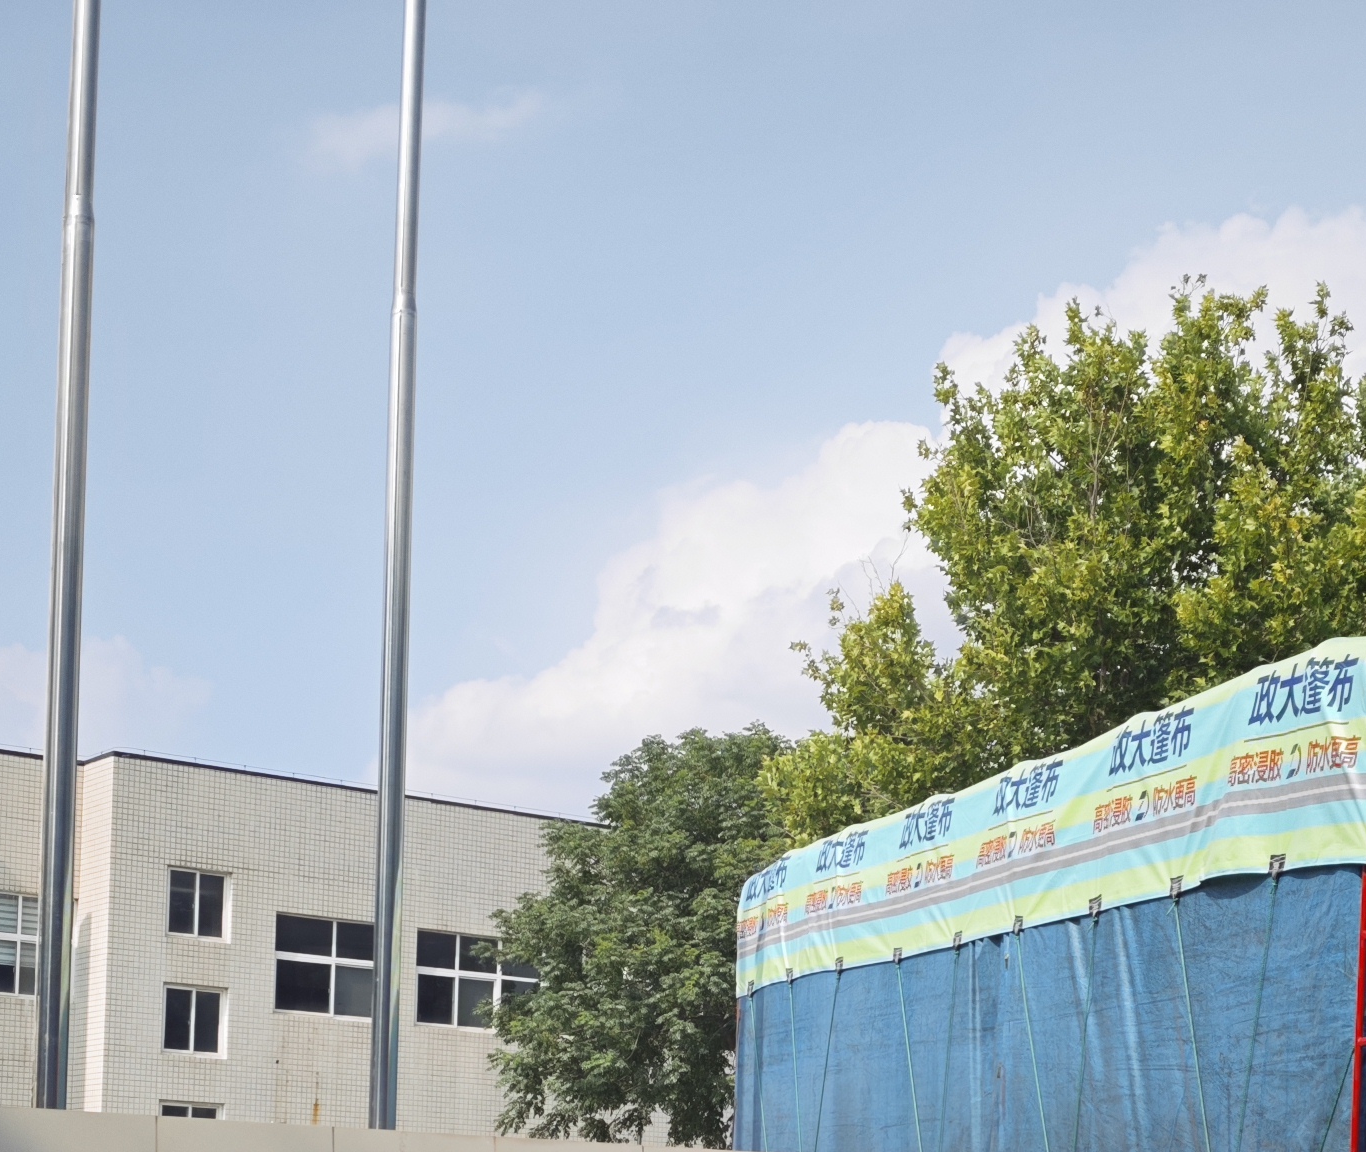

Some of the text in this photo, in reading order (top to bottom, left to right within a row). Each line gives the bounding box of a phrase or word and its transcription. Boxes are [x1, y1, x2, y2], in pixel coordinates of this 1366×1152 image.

[1248, 653, 1360, 726] 政大篷布
[1108, 705, 1195, 776] 政大篷布
[1306, 735, 1361, 775] 防水更高
